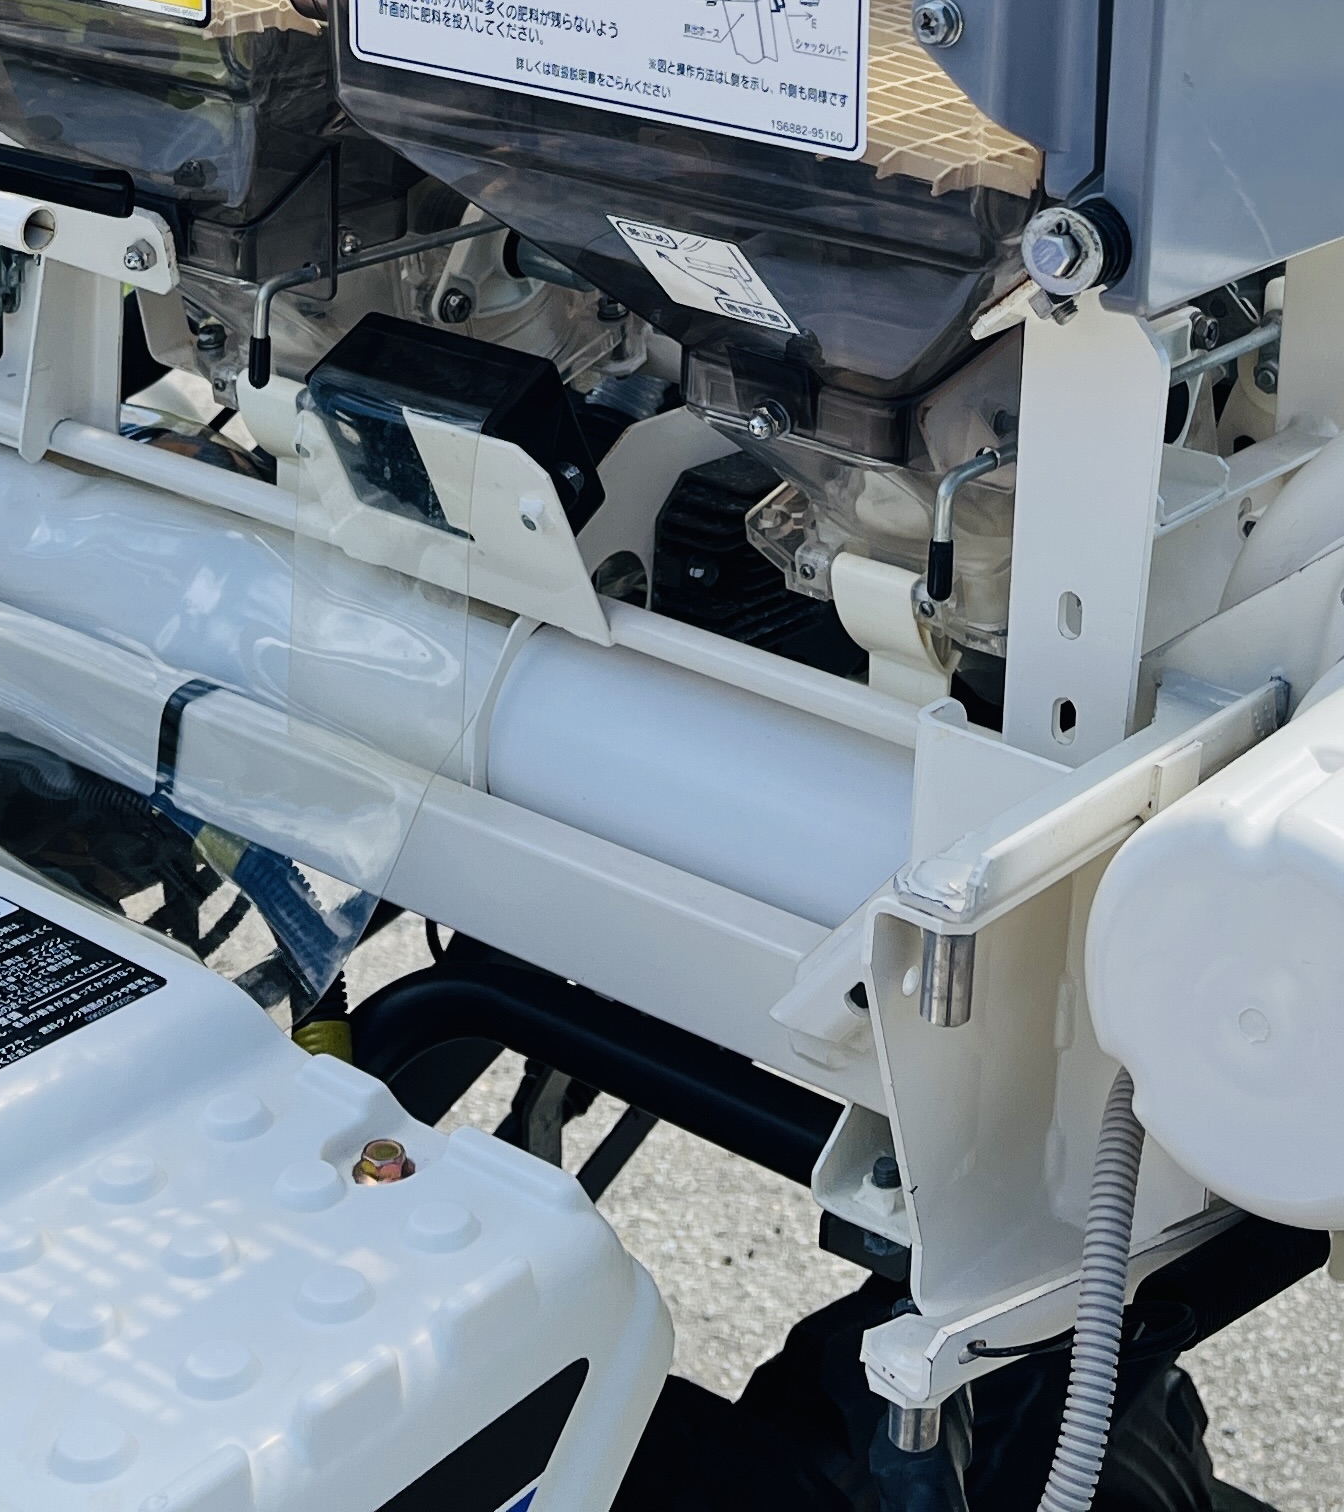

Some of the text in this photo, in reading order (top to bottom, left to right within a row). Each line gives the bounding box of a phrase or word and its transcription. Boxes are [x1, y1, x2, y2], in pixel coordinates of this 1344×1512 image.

[379, 0, 544, 45] 計画的に肥料を投入してください。
[811, 18, 816, 28] E
[795, 38, 848, 58] シャッタレバー
[515, 57, 670, 99] 詳しくは取扱説明書をごらんください
